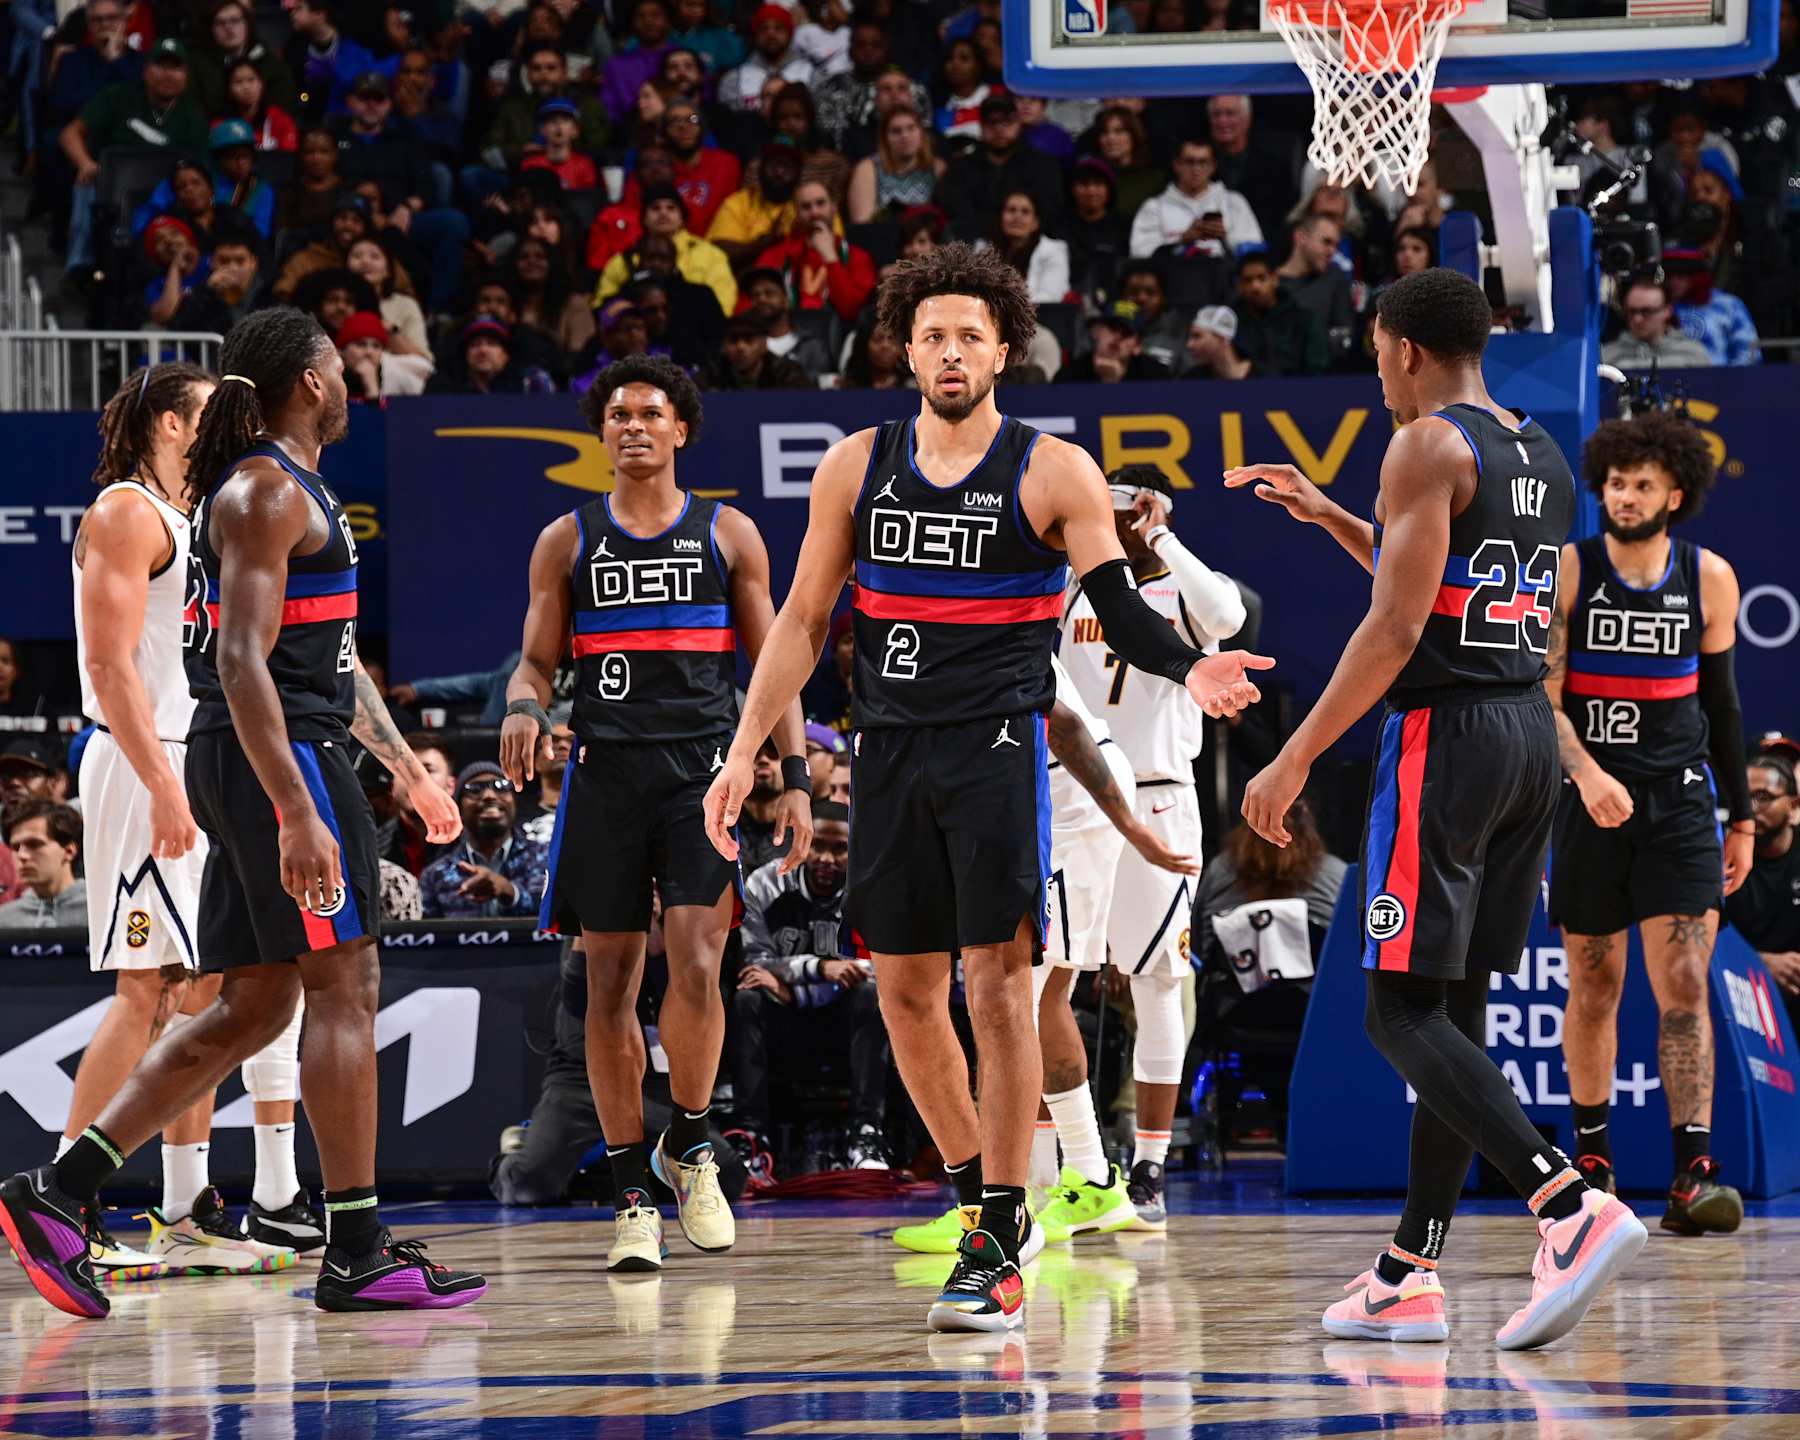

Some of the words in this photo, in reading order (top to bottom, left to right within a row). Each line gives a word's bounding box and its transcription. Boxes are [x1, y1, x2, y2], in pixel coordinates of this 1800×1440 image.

[964, 491, 1002, 508] UWM
[1511, 477, 1548, 518] IVEY
[673, 538, 702, 550] UWM
[870, 508, 998, 569] DET
[591, 557, 703, 607] DET
[1460, 538, 1560, 655] 23
[881, 623, 921, 680] 2
[1586, 608, 1690, 655] DET
[598, 653, 631, 700] 9
[1103, 652, 1131, 706] 7
[1586, 699, 1641, 744] 12
[1371, 908, 1397, 926] DET
